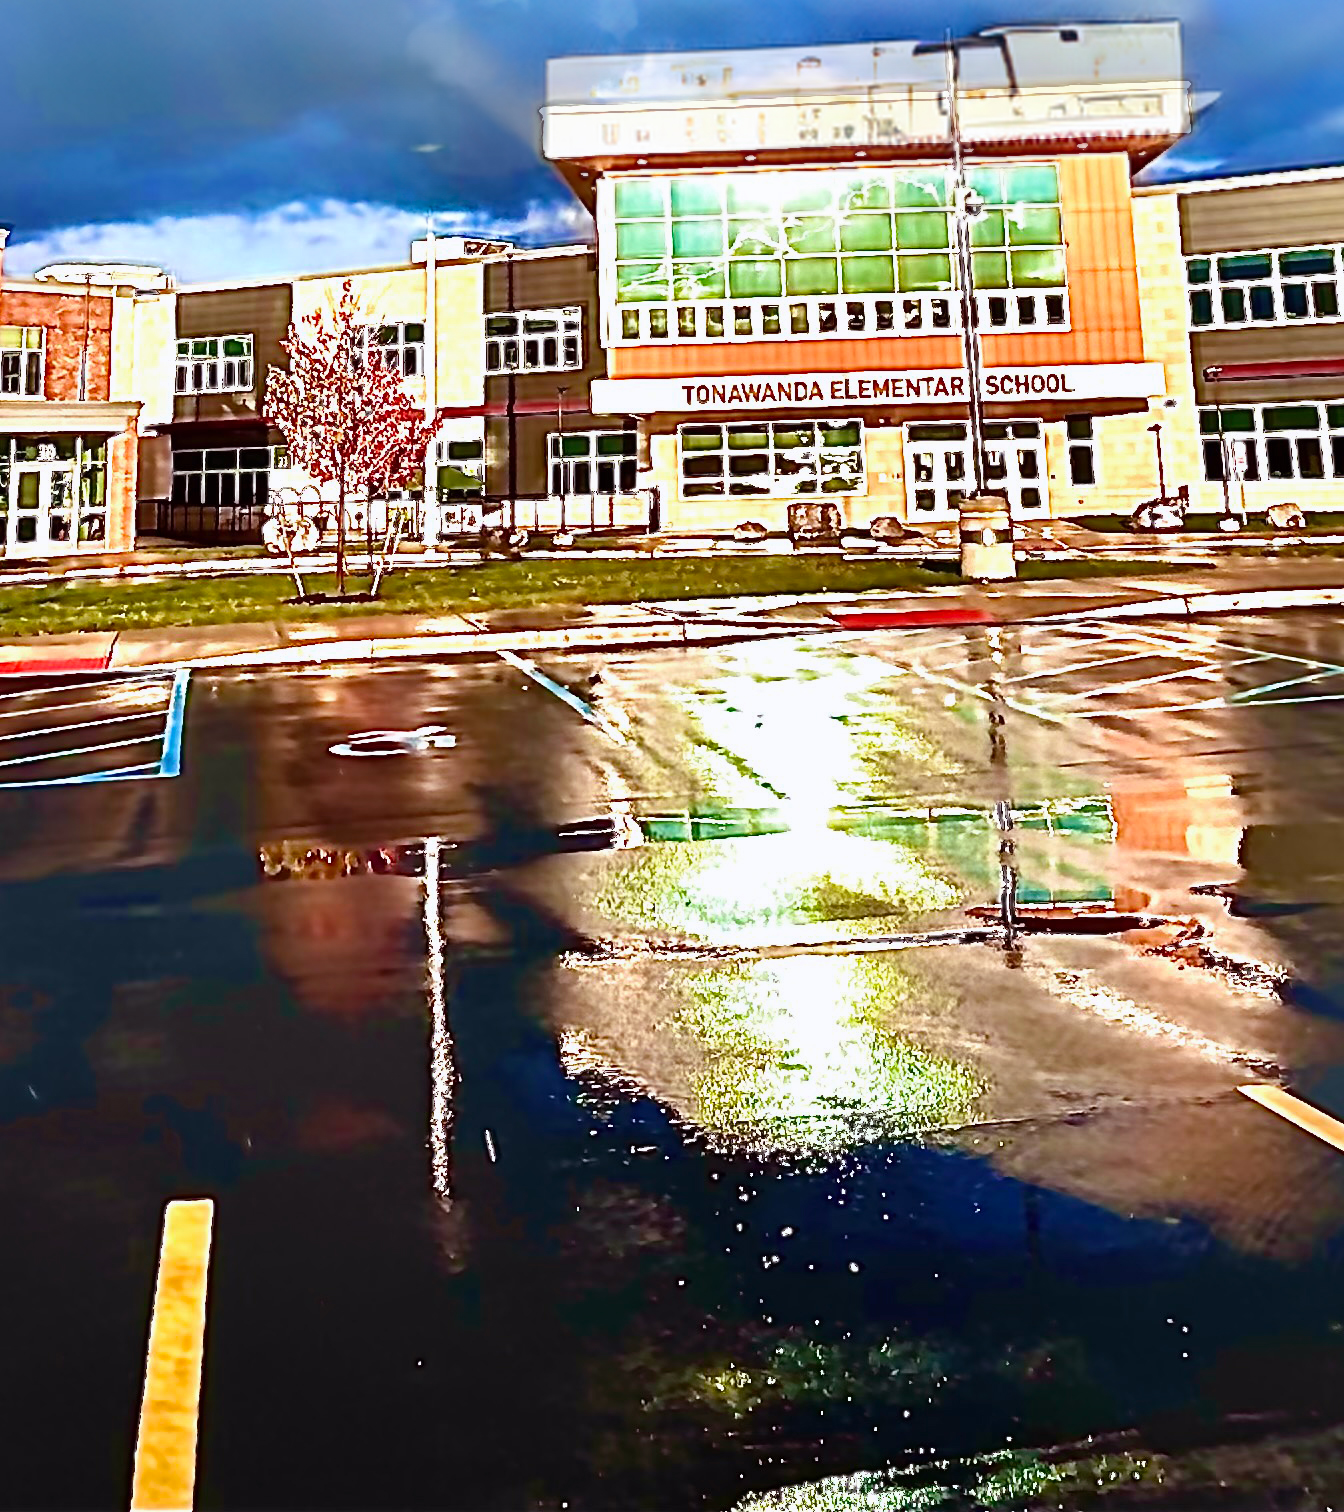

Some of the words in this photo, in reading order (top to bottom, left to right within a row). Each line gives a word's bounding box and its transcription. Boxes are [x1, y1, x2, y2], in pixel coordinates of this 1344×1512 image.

[682, 381, 824, 406] TONAWANDA
[830, 376, 965, 400] ELEMENTAR
[985, 373, 1076, 396] SCHOOL
